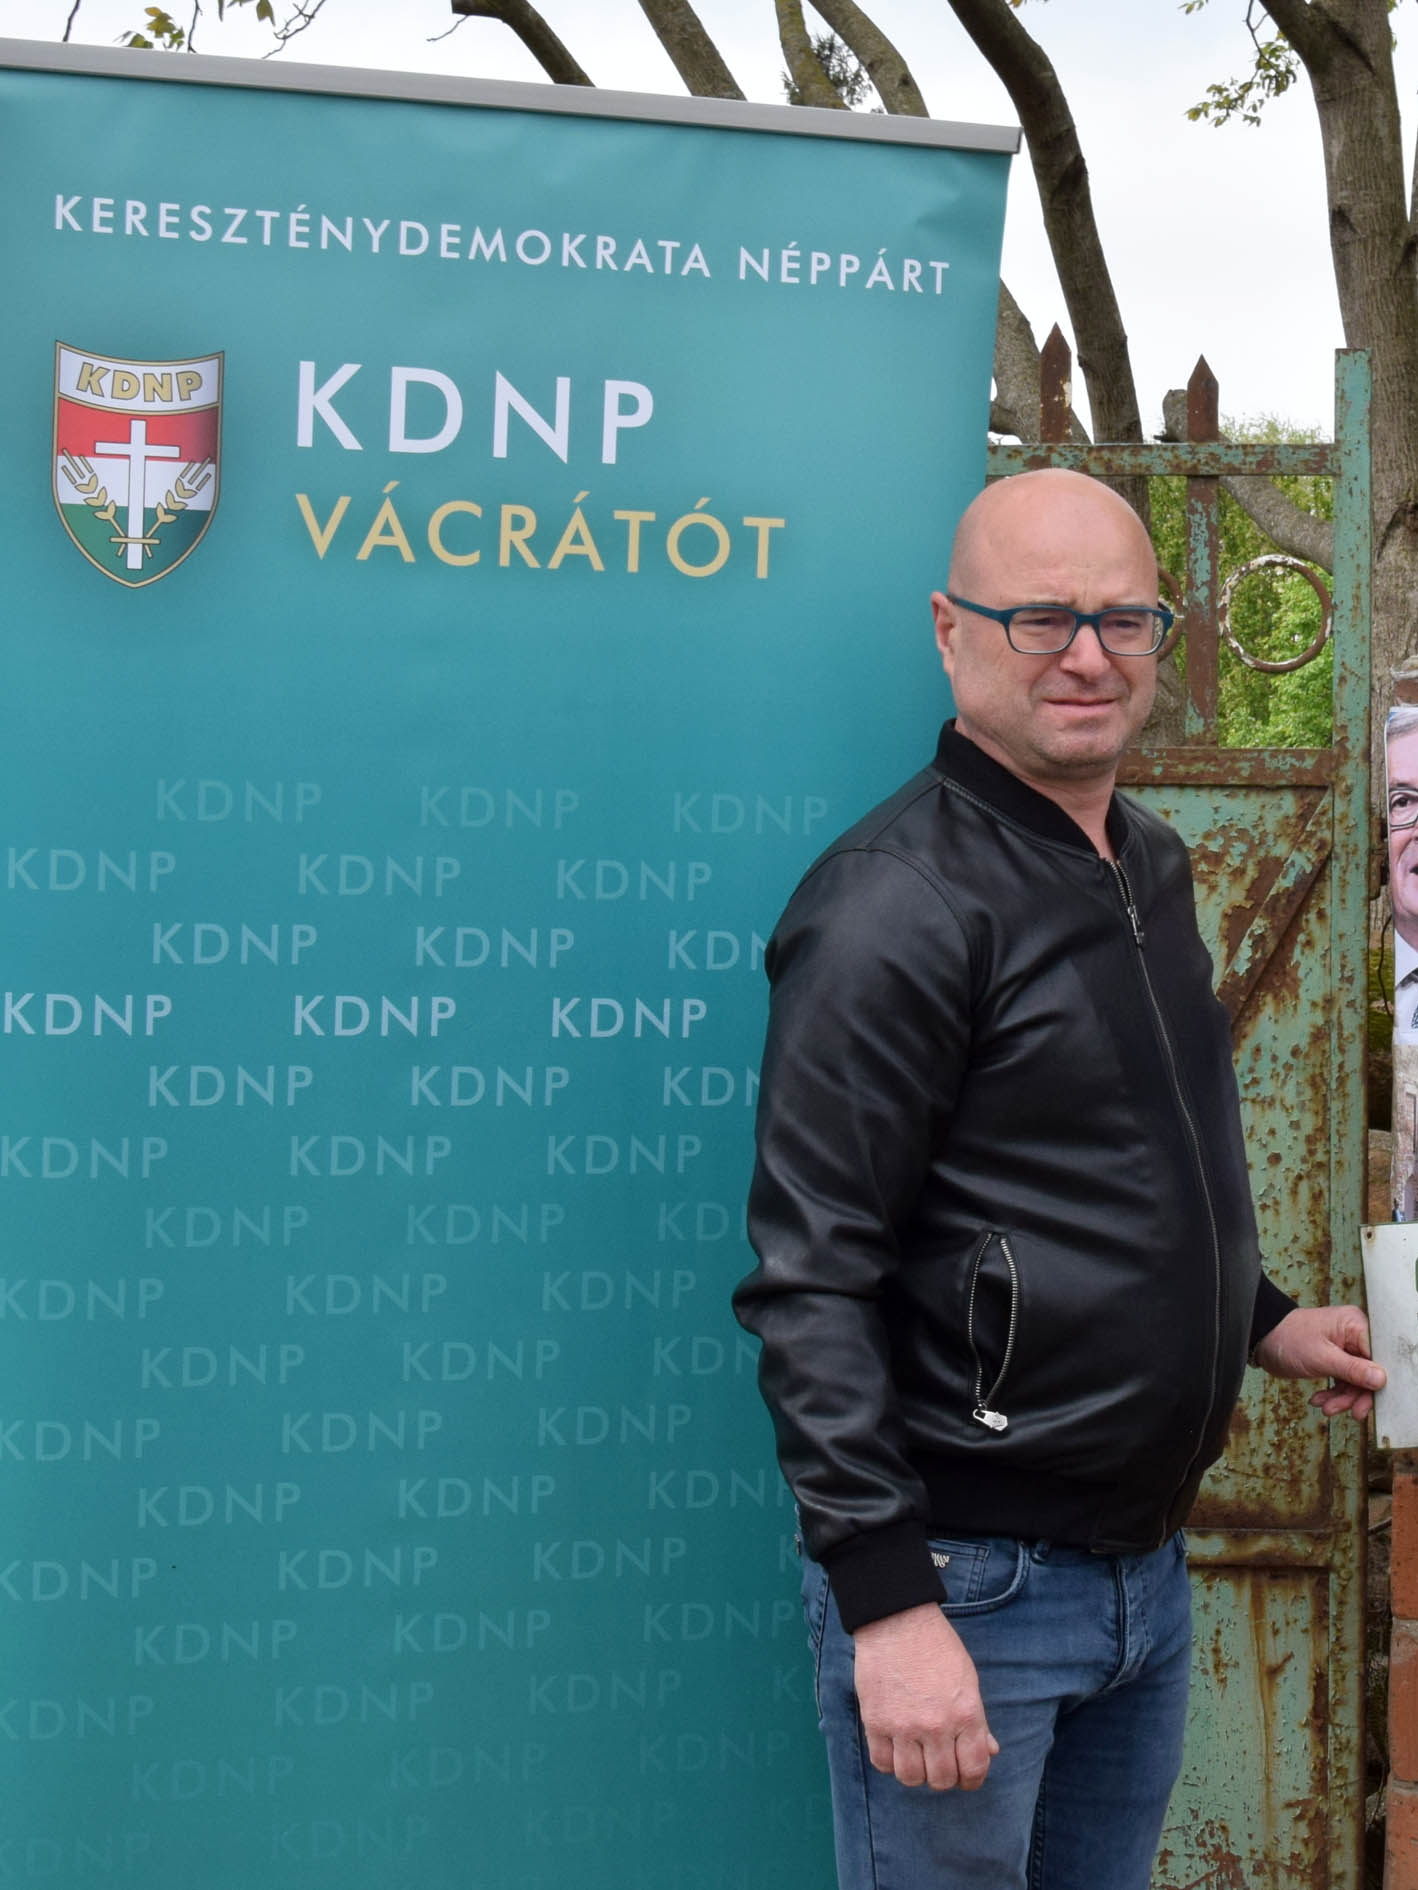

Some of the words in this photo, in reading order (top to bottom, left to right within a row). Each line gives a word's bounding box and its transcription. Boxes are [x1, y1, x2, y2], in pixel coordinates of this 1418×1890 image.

[55, 194, 711, 278] KERESZTÉNYDEMOKRATA
[738, 241, 950, 296] NÉPPÁRT
[76, 361, 204, 403] KDNP
[296, 360, 654, 465] KDNP
[295, 480, 786, 580] VÁCRÁTÓT
[157, 779, 321, 823] KDNP
[421, 786, 579, 829] KDNP
[673, 793, 827, 835] KDNP
[8, 848, 176, 891] KDNP
[299, 854, 460, 896] KDNP
[557, 859, 711, 900] KDNP
[153, 923, 317, 964] KDNP
[416, 926, 574, 967] KDNP
[669, 930, 765, 970] KD
[4, 992, 172, 1035] KDNP
[294, 995, 456, 1036] KDNP
[552, 998, 707, 1038] KDNP
[149, 1066, 313, 1106] KDNP
[411, 1066, 569, 1106] KDNP
[663, 1067, 759, 1106] KD
[0, 1136, 167, 1179] KDNP
[290, 1136, 451, 1176] KDNP
[547, 1135, 702, 1174] KDNP
[145, 1205, 309, 1248] KDNP
[407, 1203, 564, 1244] KDNP
[657, 1201, 747, 1242] KD
[0, 1278, 164, 1320] KDNP
[287, 1273, 447, 1314] KDNP
[542, 1270, 697, 1311] KDNP
[141, 1344, 304, 1388] KDNP
[402, 1339, 560, 1381] KDNP
[282, 1410, 442, 1453] KDNP
[538, 1403, 691, 1445] KDNP
[138, 1482, 301, 1528] KDNP
[398, 1475, 556, 1518] KDNP
[279, 1546, 438, 1590] KDNP
[533, 1537, 686, 1581] KDNP
[135, 1619, 297, 1665] KDNP
[393, 1610, 551, 1653] KDNP
[644, 1601, 795, 1642] KDNP
[275, 1682, 435, 1726] KDNP
[529, 1669, 682, 1713] KDNP
[130, 1755, 294, 1802] KDNP
[390, 1744, 546, 1789] KDNP
[639, 1731, 788, 1774] KDNP
